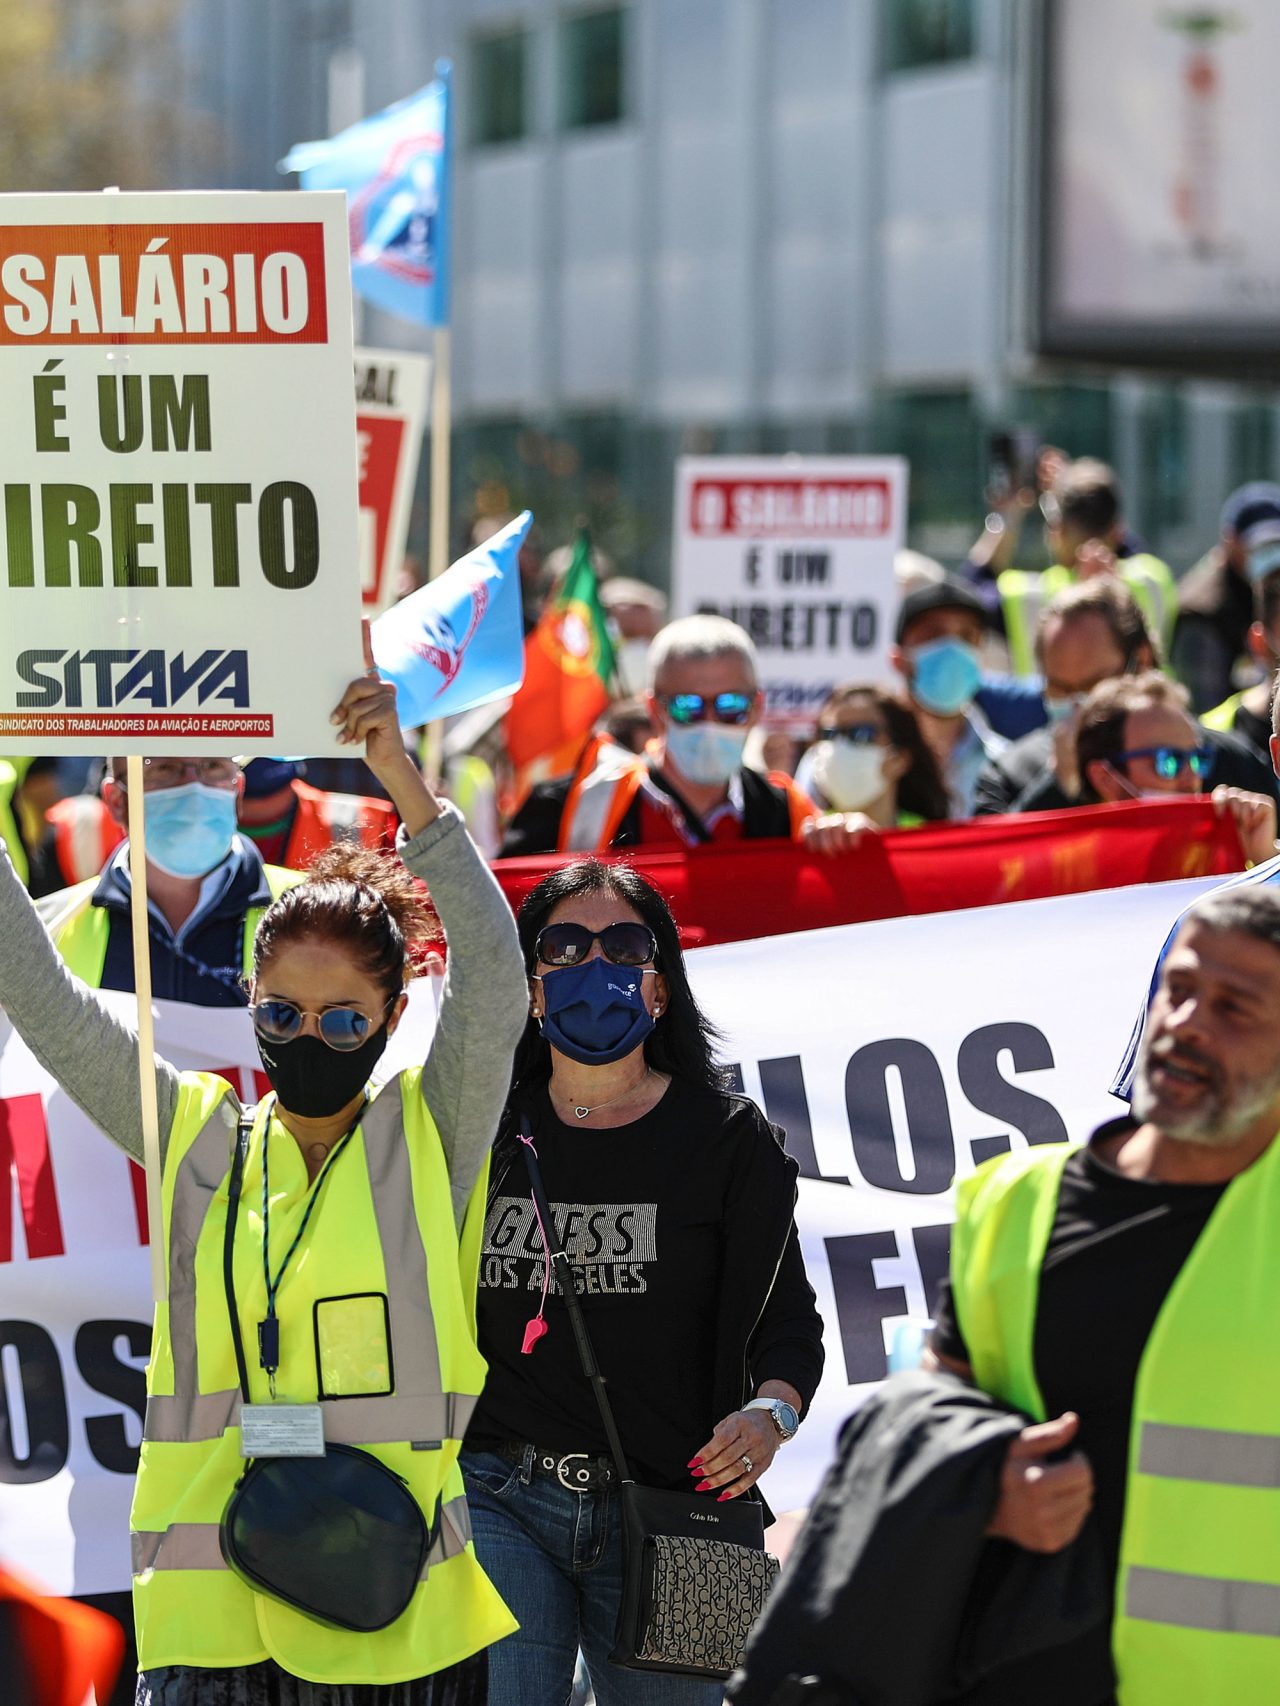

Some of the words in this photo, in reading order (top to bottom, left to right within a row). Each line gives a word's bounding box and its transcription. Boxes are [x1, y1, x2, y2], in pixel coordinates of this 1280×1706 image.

[1, 237, 310, 335] SALÁRIO
[33, 358, 70, 453] É
[97, 374, 213, 454] UM
[15, 649, 250, 708] SITAVA
[46, 719, 66, 732] DOS
[67, 719, 146, 732] TRABALHADORES
[146, 720, 162, 732] DA
[162, 717, 201, 734] AVIAÇÃO
[210, 720, 271, 732] AEROPORTOS
